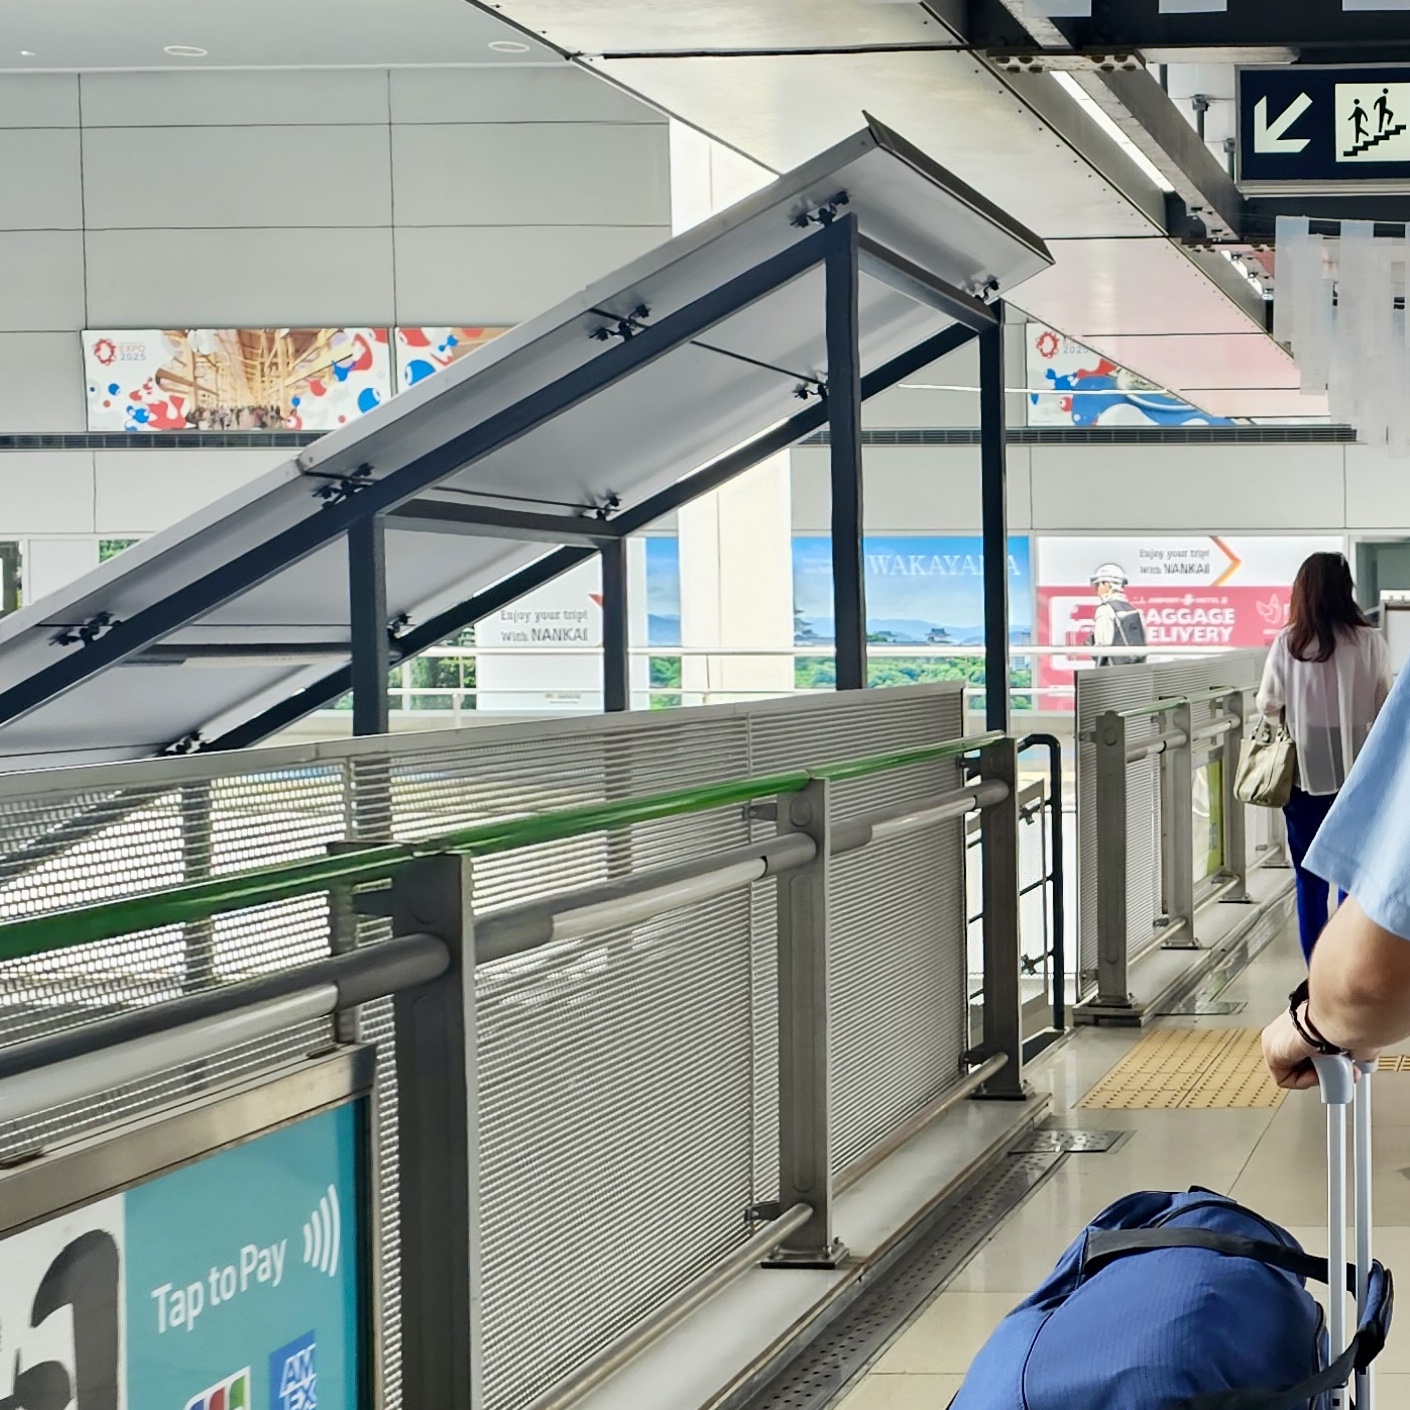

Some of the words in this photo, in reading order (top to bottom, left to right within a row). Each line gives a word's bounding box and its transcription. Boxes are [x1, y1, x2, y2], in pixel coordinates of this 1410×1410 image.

[867, 554, 1021, 576] WAKAYAA
[500, 610, 531, 623] Enjoy
[534, 610, 560, 623] your
[500, 631, 528, 642] With
[531, 628, 588, 642] NANKAI
[1146, 626, 1234, 642] ELIVERY
[150, 1280, 206, 1335] Tap
[208, 1261, 238, 1307] to
[238, 1237, 288, 1296] Pay
[278, 1343, 318, 1393] AM
